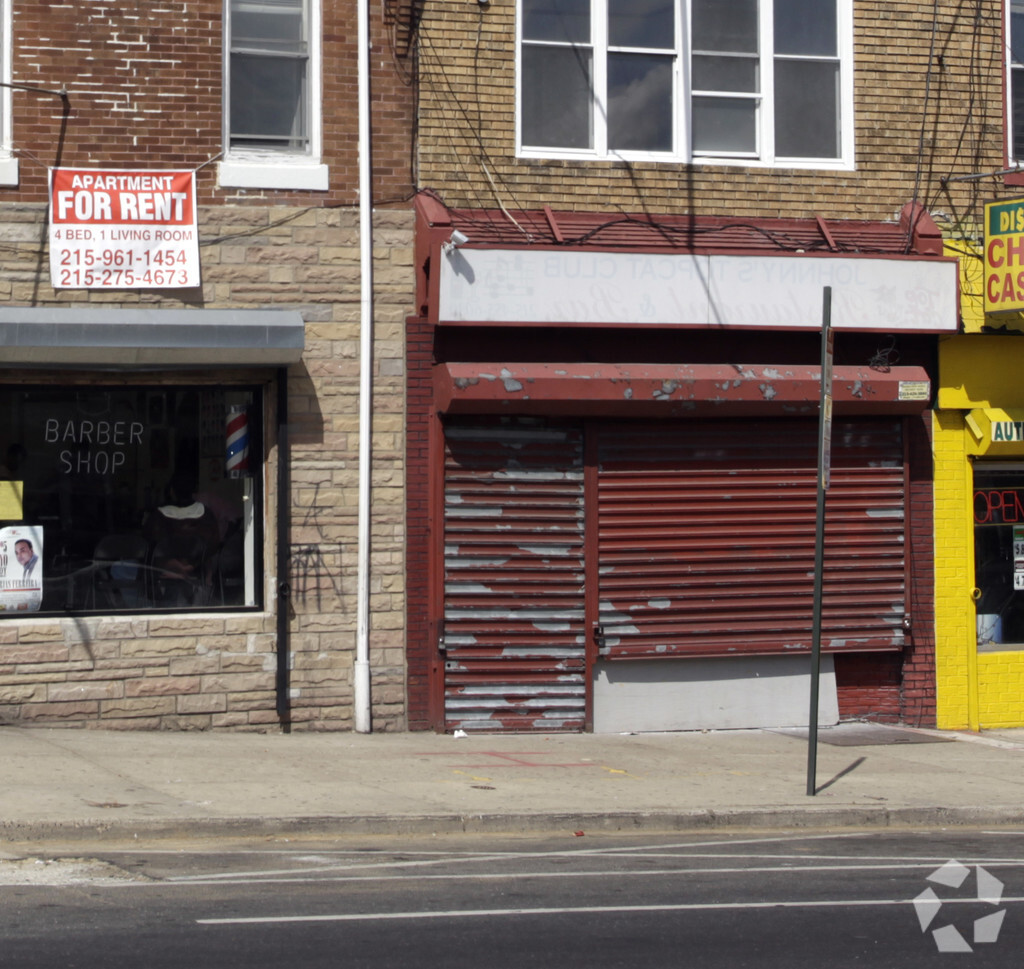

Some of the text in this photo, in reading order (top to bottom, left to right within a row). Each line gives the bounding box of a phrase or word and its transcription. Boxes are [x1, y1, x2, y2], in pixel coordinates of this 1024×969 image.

[71, 175, 174, 191] APARTMENT
[57, 190, 187, 221] FOR RENT
[55, 230, 192, 242] 4 BED, 1 LIVING ROOM
[60, 249, 187, 266] 215-961-1454
[987, 235, 1024, 268] CH
[60, 269, 188, 286] 215-275-4673
[987, 271, 1024, 303] CAS
[44, 418, 144, 445] BARBER
[994, 422, 1024, 441] AUT
[59, 450, 125, 475] SHOP
